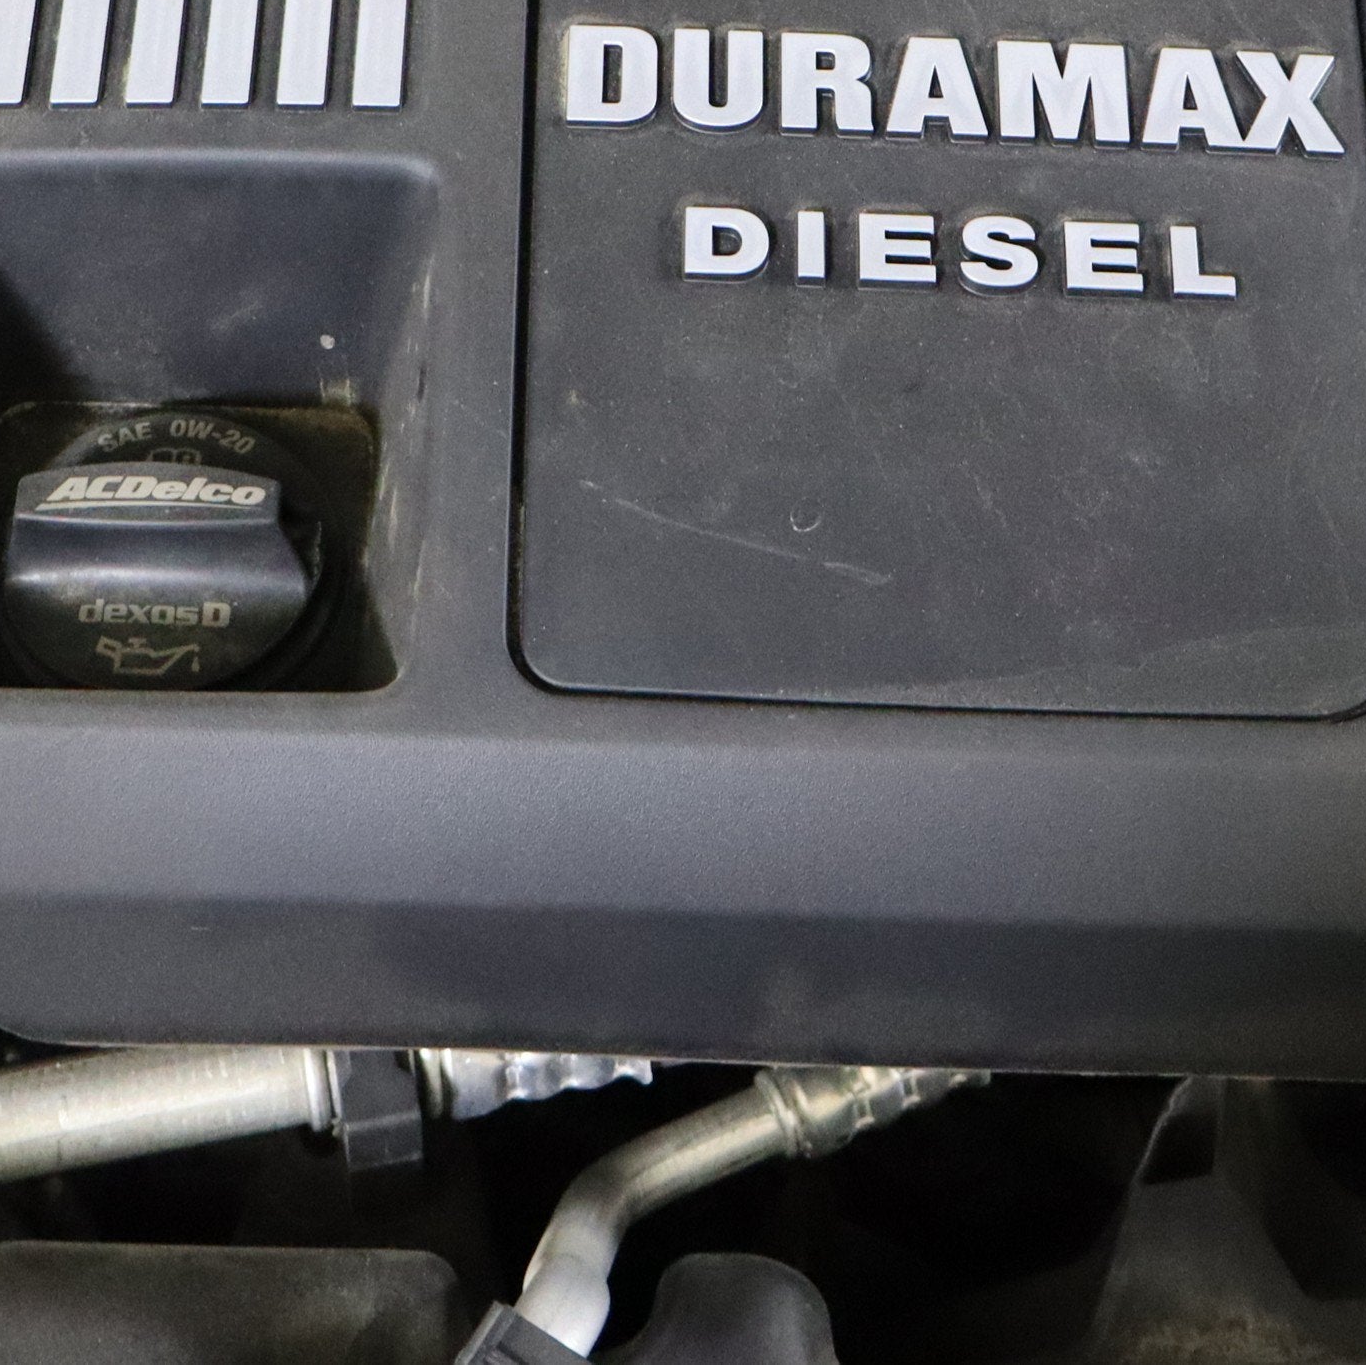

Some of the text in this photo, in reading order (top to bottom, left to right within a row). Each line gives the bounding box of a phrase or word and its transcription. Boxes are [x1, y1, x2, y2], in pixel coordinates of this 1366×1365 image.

[564, 23, 1346, 157] DURAMAX
[682, 205, 1237, 299] DIESEL
[97, 418, 257, 455] SAE 0W-20
[45, 474, 267, 506] ACDelco
[78, 598, 232, 629] dexosD
